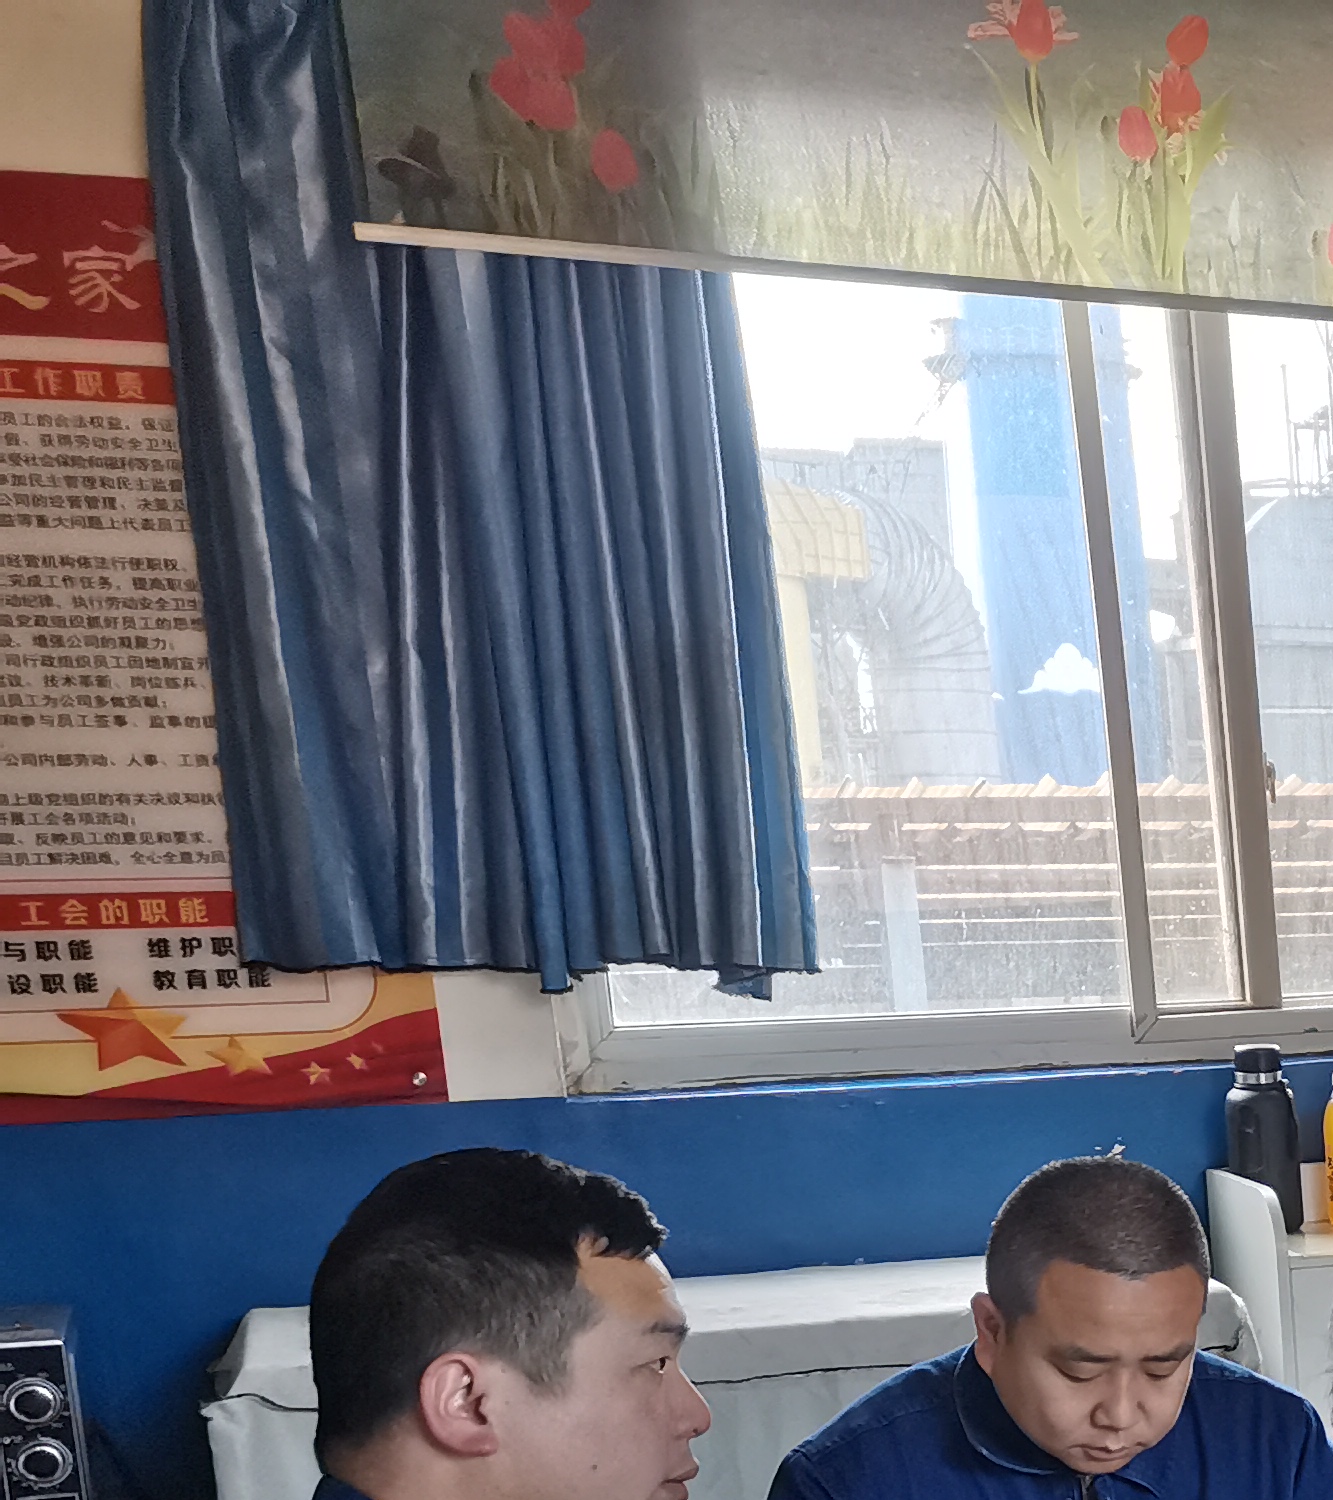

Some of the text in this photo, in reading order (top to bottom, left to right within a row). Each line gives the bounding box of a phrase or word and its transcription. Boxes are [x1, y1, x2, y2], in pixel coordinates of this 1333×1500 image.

[19, 897, 211, 926] 工会的职能
[0, 939, 95, 962] 与职能
[7, 967, 272, 996] 设职能 教育职能
